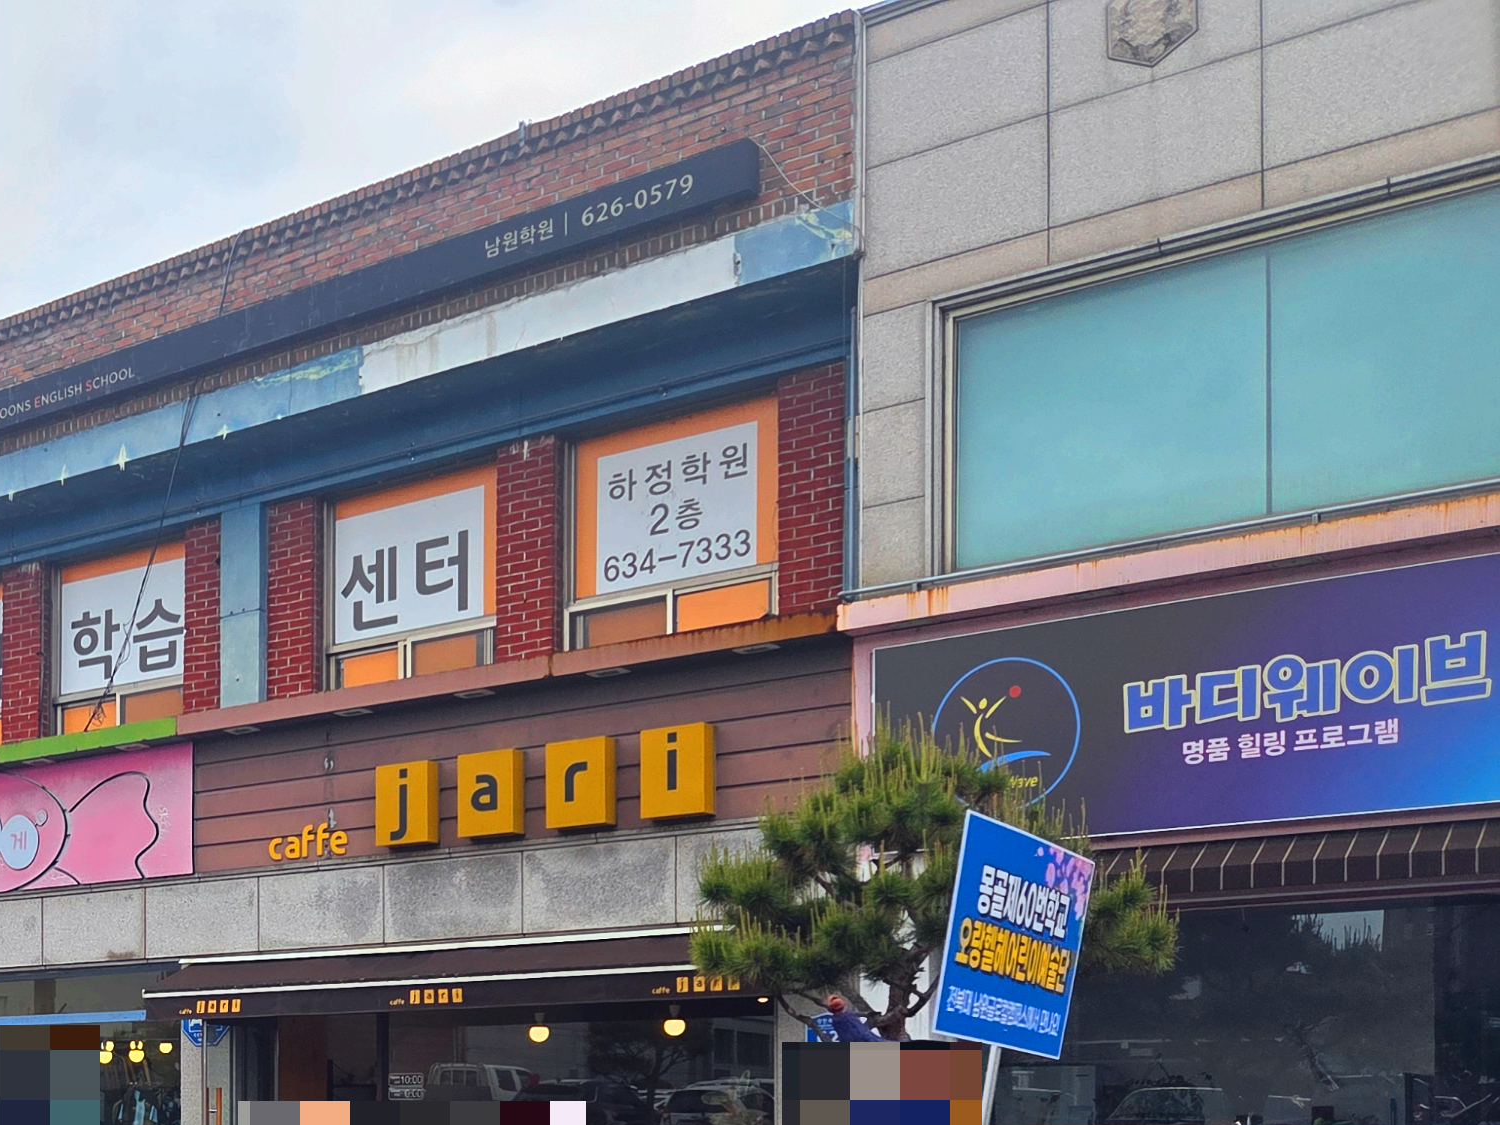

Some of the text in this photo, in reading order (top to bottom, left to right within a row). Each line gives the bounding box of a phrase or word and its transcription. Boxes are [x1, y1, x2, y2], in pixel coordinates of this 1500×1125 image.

[483, 172, 695, 259] 남원학원 626-0579
[33, 383, 83, 409] ENGLISH
[84, 367, 135, 394] SCHOOL
[608, 442, 750, 500] 하정학원
[649, 503, 703, 537] 2층
[604, 530, 752, 584] 634-7333
[71, 598, 185, 682] 학습
[341, 528, 470, 632] 센터
[1122, 630, 1493, 735] 바디웨이브
[1181, 718, 1400, 766] 명품 힐링 프로그램
[269, 730, 680, 861] caffe jari
[977, 864, 1071, 939] 몽골제60번학교
[410, 988, 463, 1004] jari
